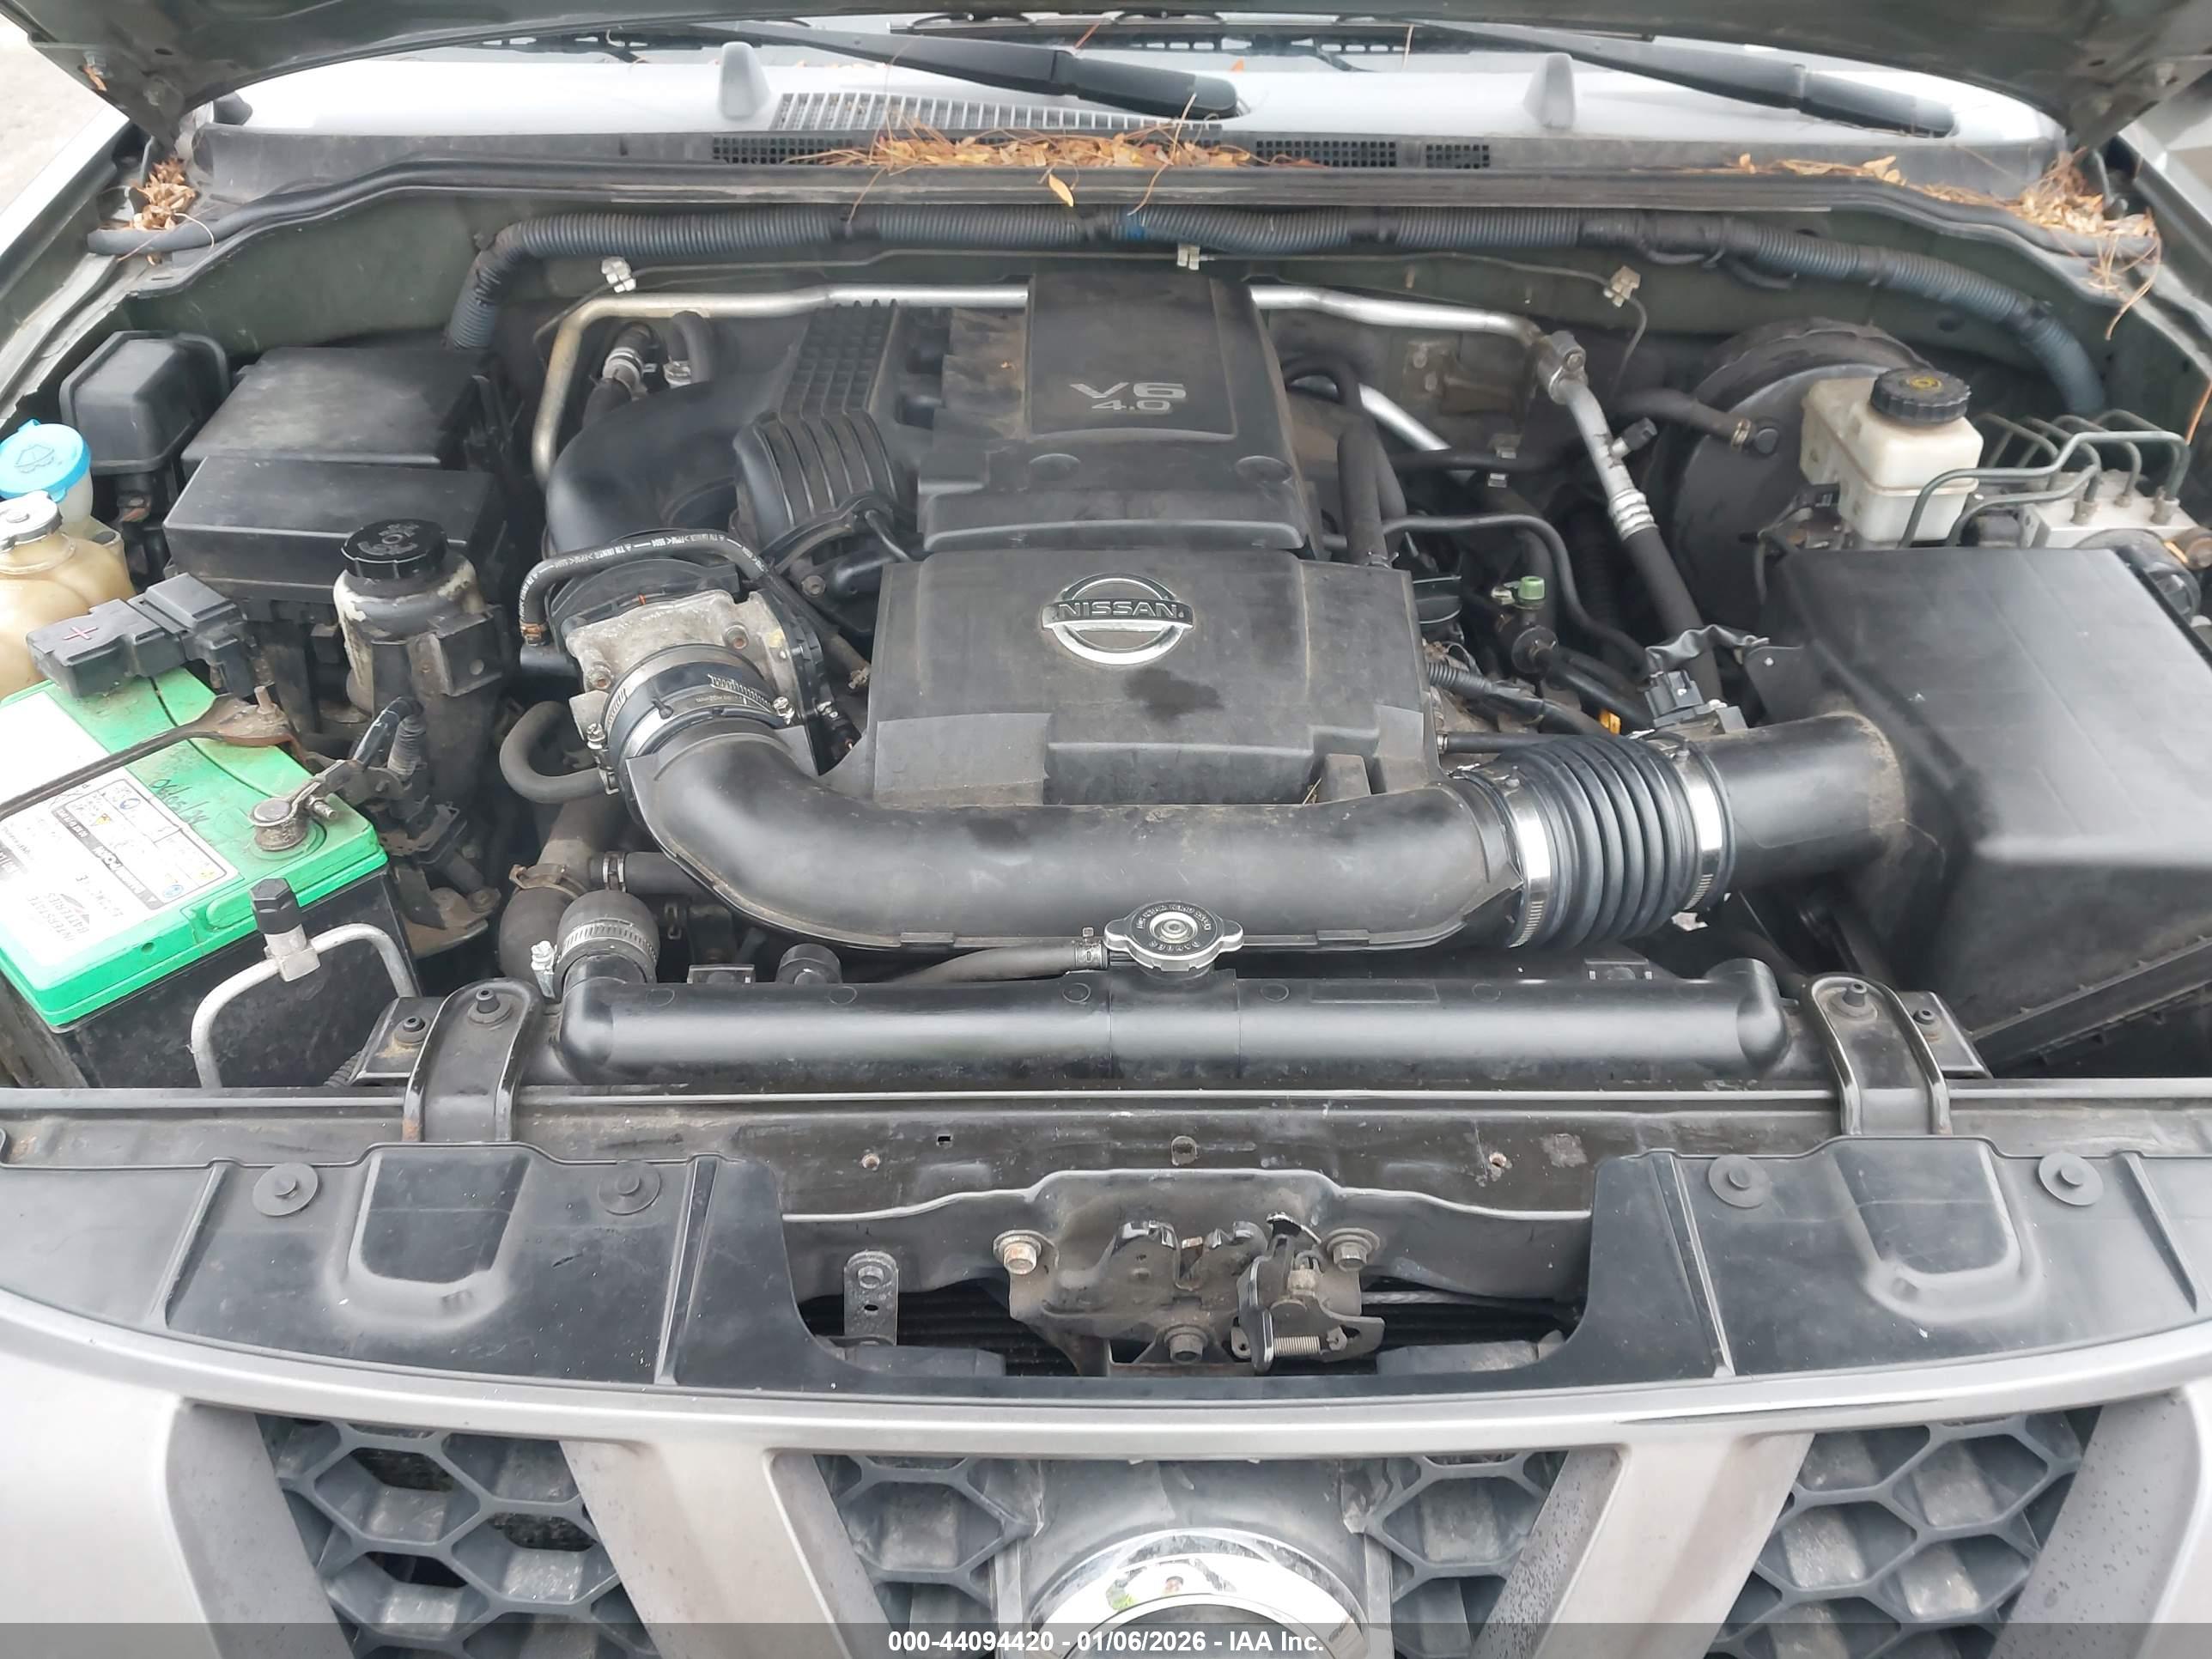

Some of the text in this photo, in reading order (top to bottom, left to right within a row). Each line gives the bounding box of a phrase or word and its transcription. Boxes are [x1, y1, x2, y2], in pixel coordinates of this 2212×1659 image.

[1070, 382, 1187, 400] V6
[1091, 399, 1171, 412] 4.0
[1059, 601, 1177, 619] NISSAN
